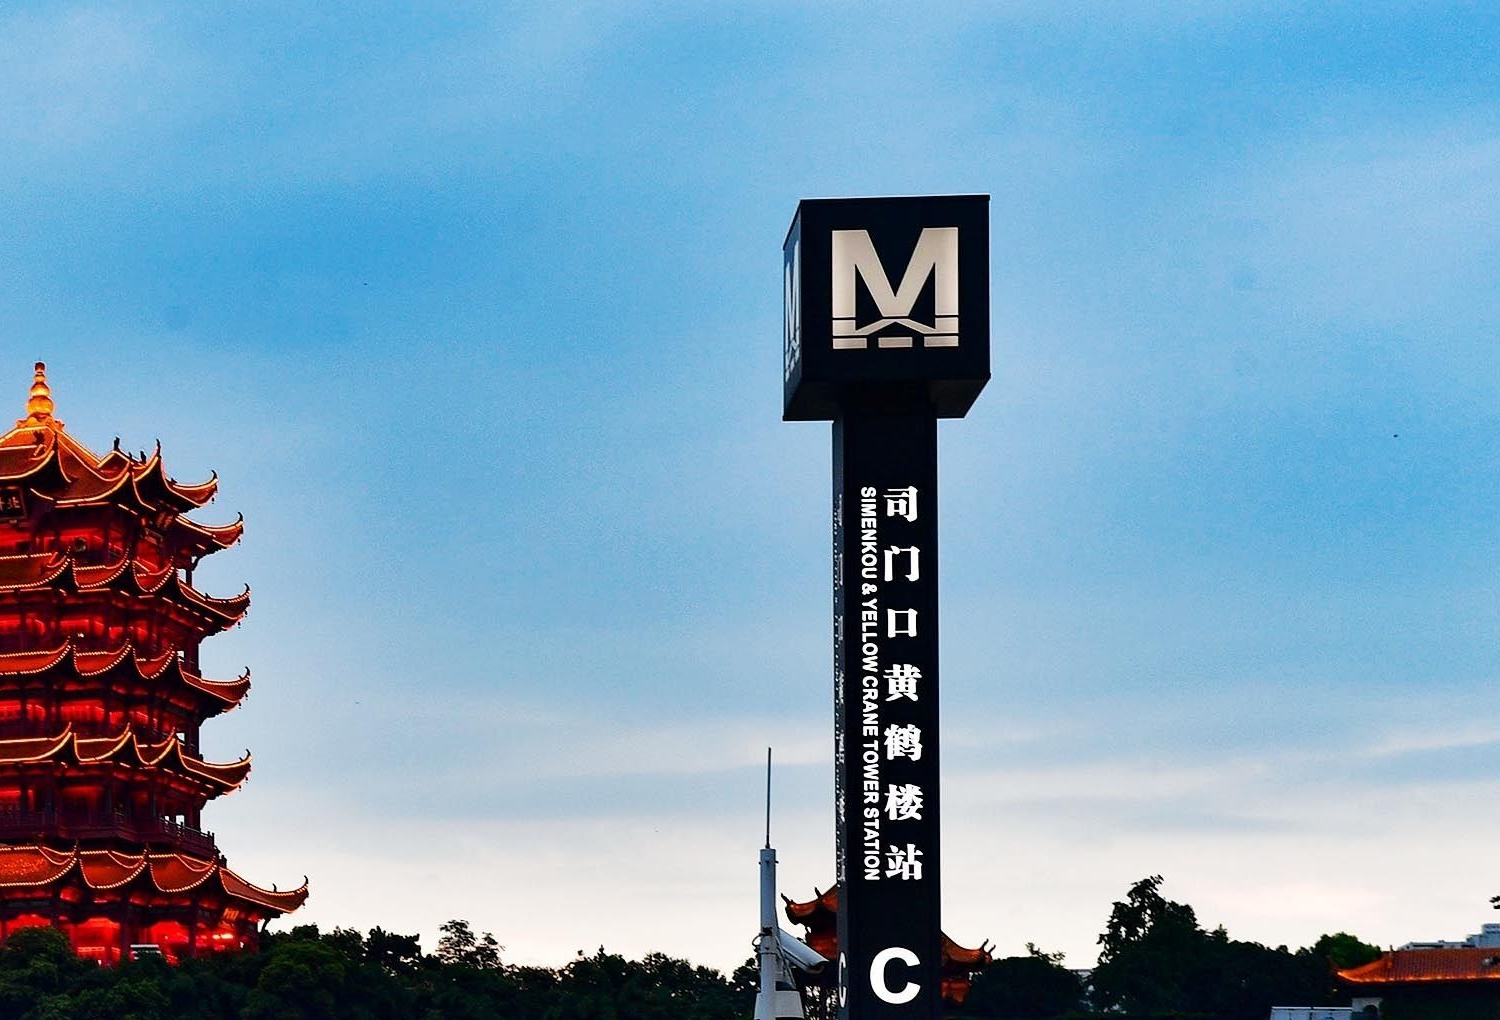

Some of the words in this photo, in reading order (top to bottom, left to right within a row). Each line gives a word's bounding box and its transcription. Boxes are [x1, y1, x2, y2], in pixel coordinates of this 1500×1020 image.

[861, 486, 878, 579] SIMENKOU
[862, 582, 878, 596] &
[862, 598, 879, 672] YELLOW
[862, 675, 880, 737] CRANE
[883, 485, 924, 880] 司门口黄鹤楼站
[863, 740, 880, 804] TOWER
[863, 807, 881, 881] STATION
[870, 946, 921, 1005] C
